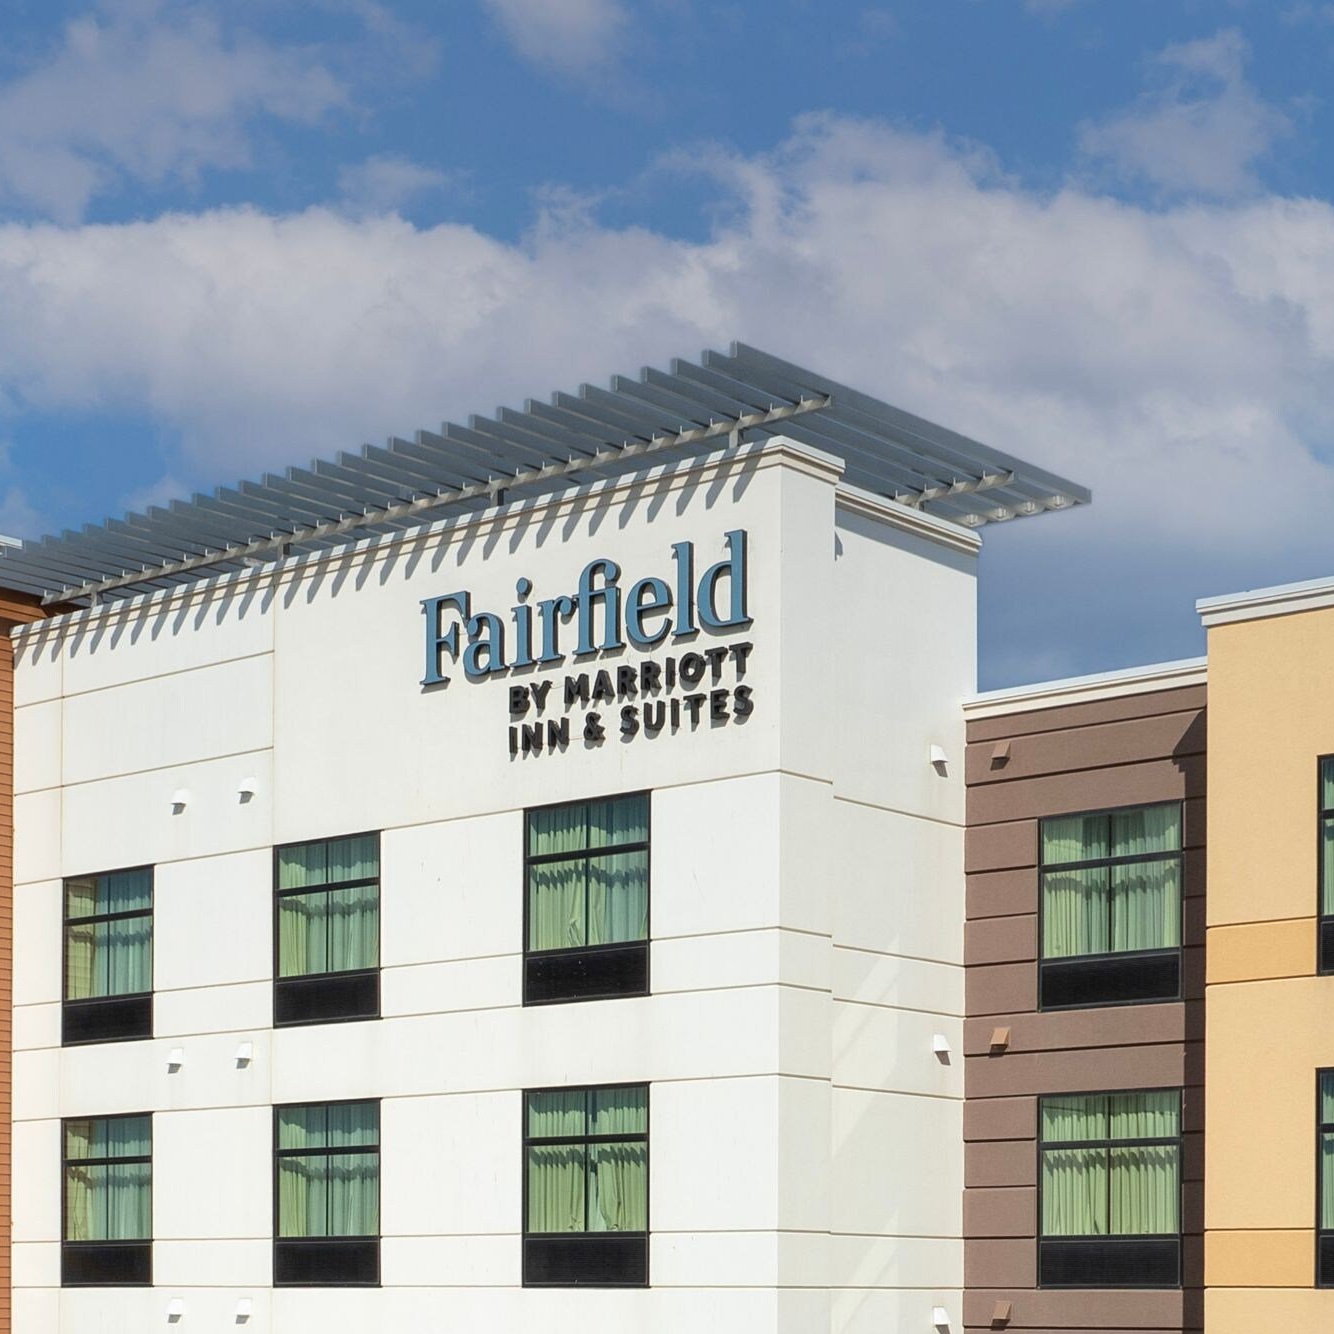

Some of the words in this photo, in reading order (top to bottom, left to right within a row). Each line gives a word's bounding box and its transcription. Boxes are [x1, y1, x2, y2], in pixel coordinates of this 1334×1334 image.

[419, 529, 754, 686] Fairfield
[509, 680, 553, 714] BY
[564, 641, 754, 705] MARRIOTT
[509, 717, 570, 754] INN
[583, 711, 606, 742] &
[620, 685, 755, 736] SUITES
